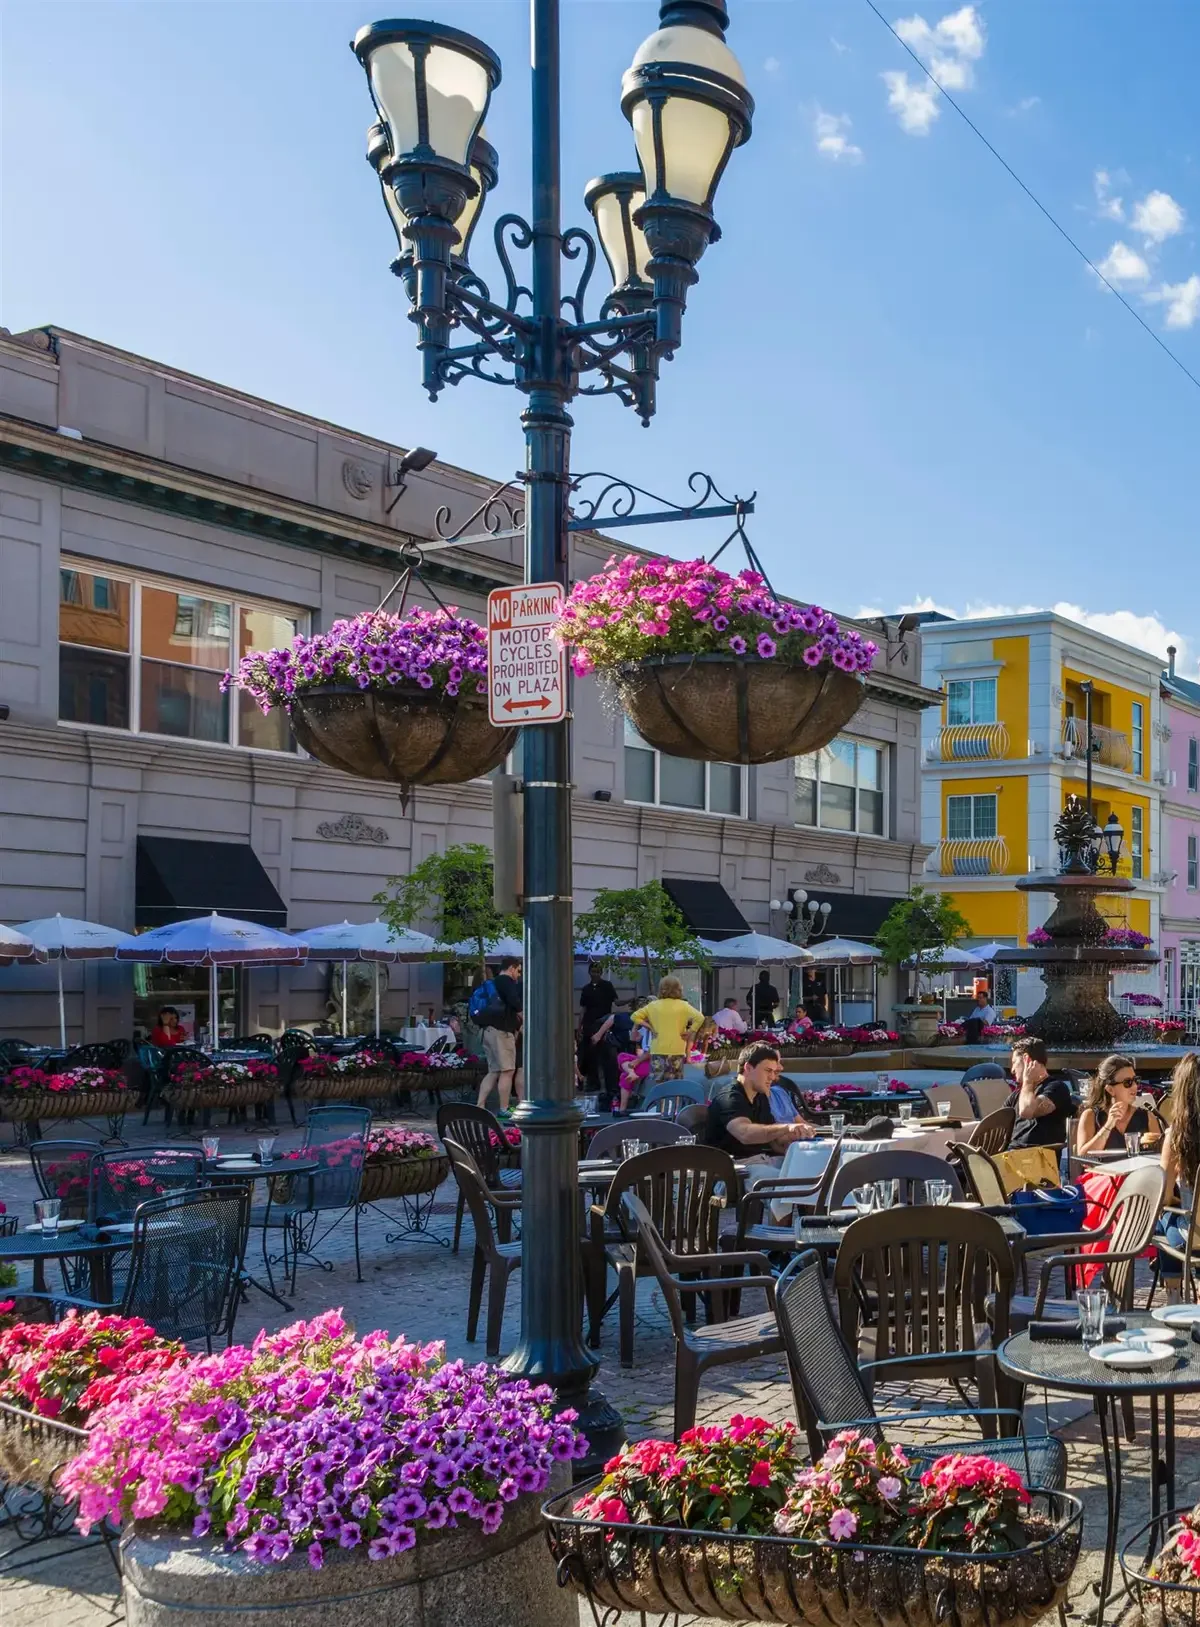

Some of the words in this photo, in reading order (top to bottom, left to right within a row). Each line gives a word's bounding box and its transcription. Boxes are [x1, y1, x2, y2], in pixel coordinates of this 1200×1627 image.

[491, 597, 510, 623] NO
[512, 596, 557, 618] PARKING
[500, 627, 550, 646] MOTOR
[500, 644, 552, 663] CYCLES
[493, 660, 559, 680] PROHIBITED
[494, 681, 511, 697] ON
[518, 677, 560, 695] PLAZA
